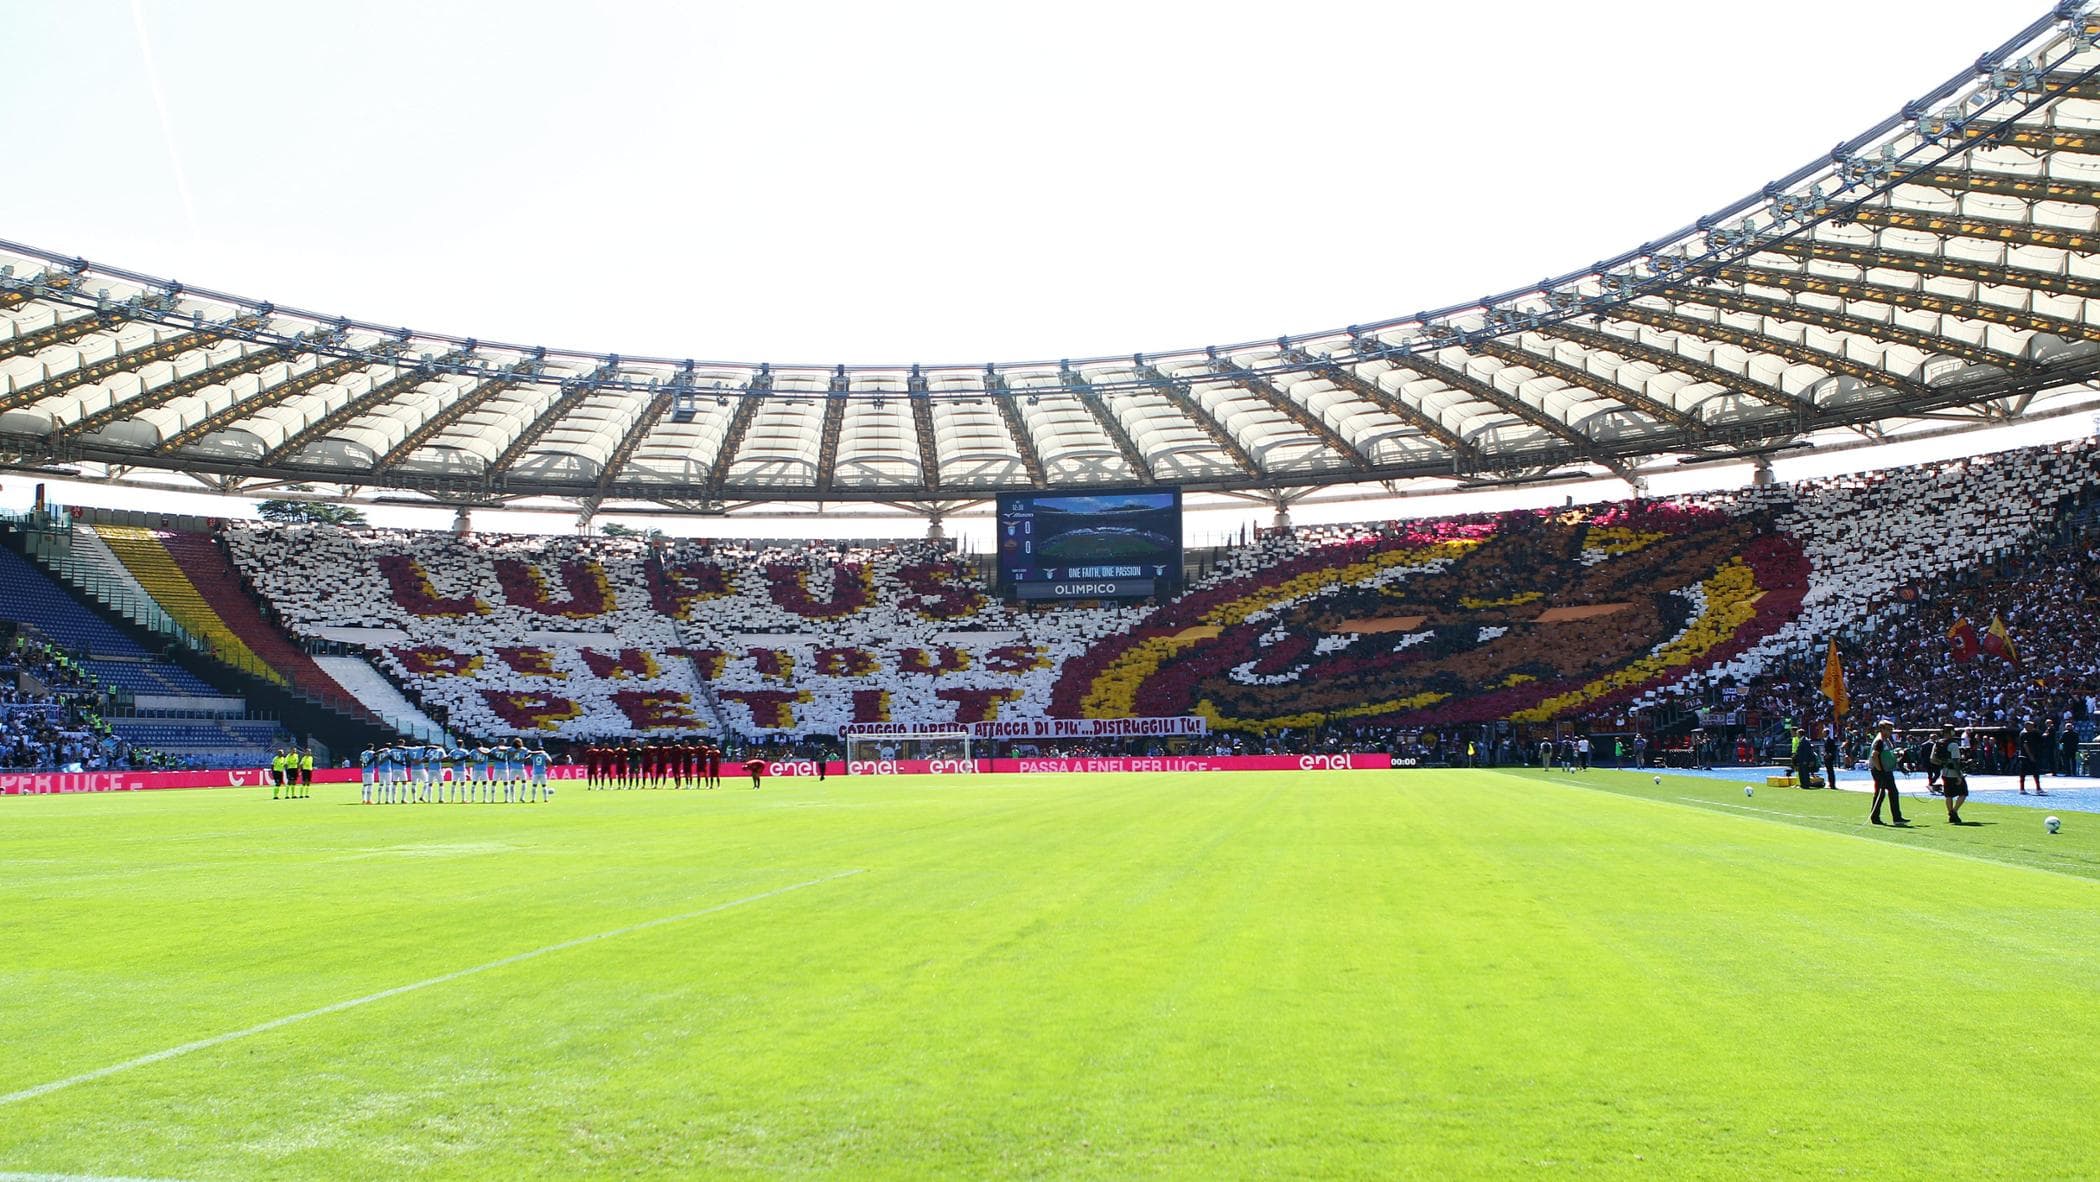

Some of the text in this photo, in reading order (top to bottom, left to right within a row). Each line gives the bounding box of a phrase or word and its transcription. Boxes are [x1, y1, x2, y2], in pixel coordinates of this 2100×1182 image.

[1068, 565, 1141, 579] ONE FAITH, ONE PASSION
[1055, 583, 1116, 595] OLIMPICO
[974, 721, 1029, 738] ATTACCA
[1035, 720, 1049, 736] DI
[1180, 717, 1201, 733] TU!
[536, 756, 542, 766] 9
[1019, 761, 1067, 772] PASSA
[1074, 761, 1085, 772] A
[1131, 760, 1162, 772] PER
[1299, 754, 1352, 770] enel
[1391, 758, 1416, 766] 00:00
[769, 761, 818, 776] enel
[60, 773, 124, 793] LUCE
